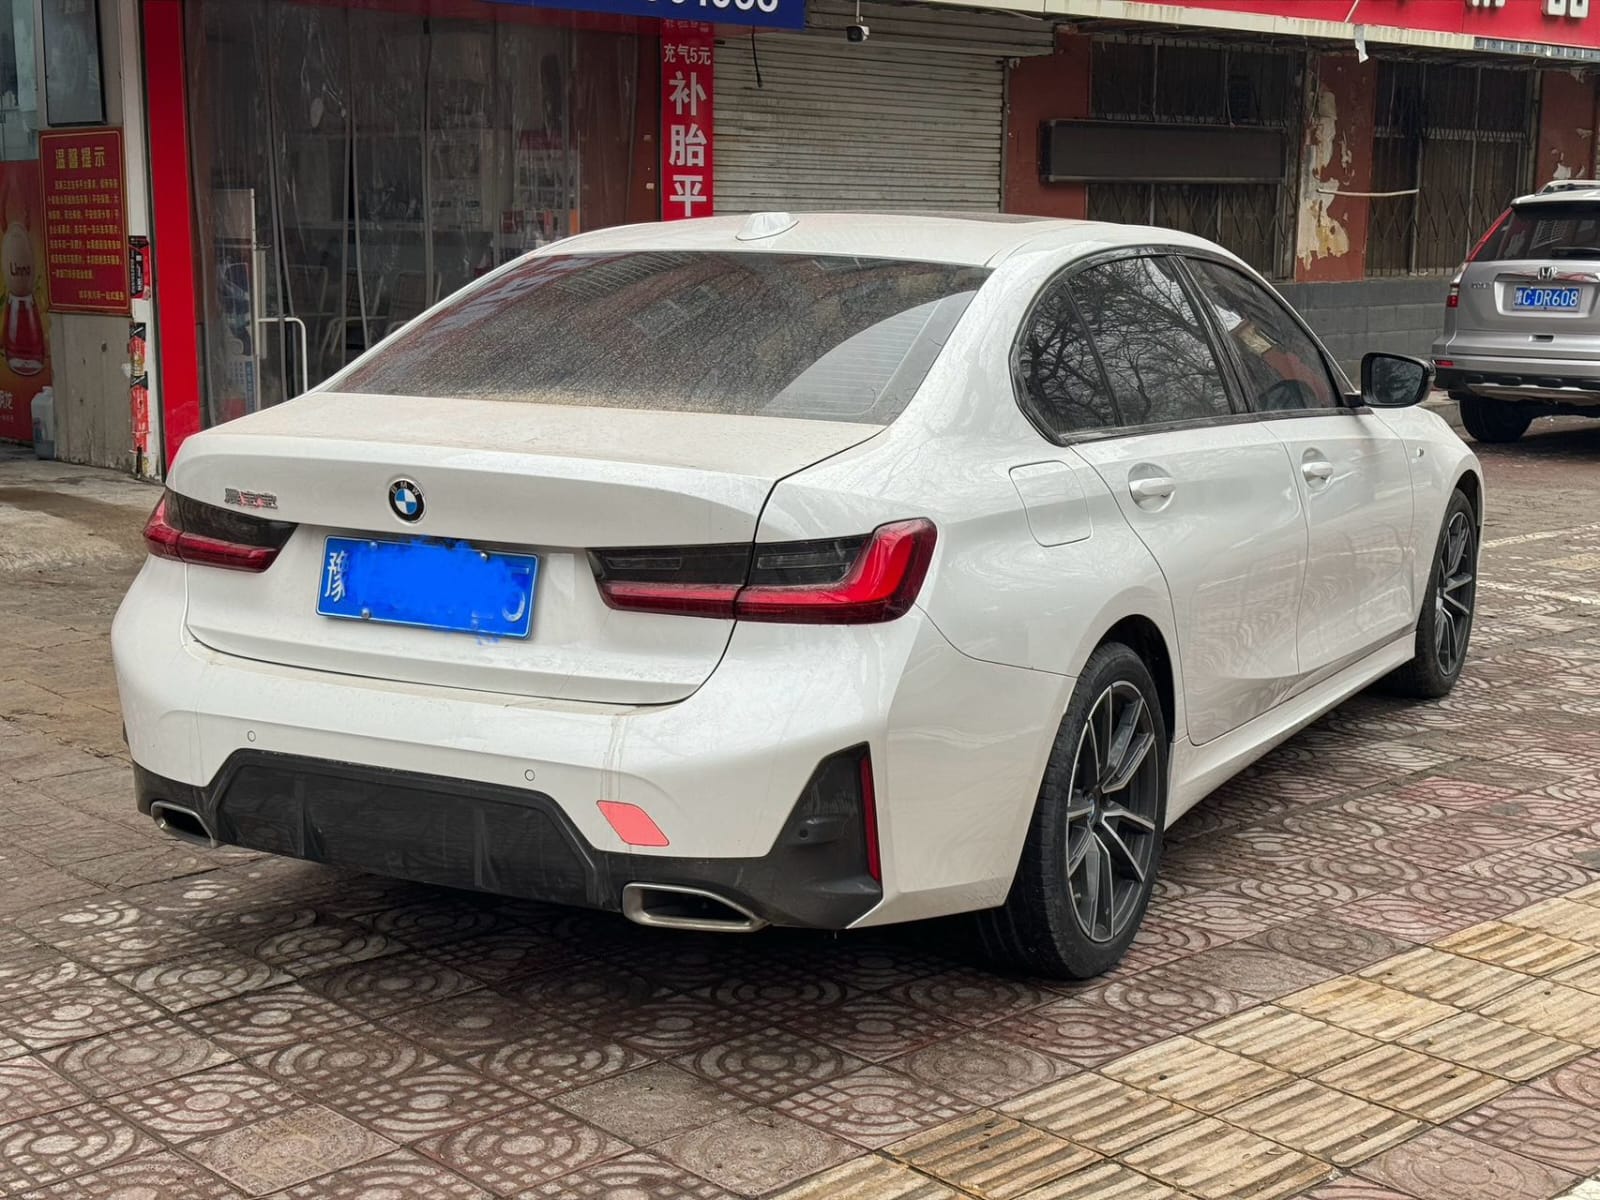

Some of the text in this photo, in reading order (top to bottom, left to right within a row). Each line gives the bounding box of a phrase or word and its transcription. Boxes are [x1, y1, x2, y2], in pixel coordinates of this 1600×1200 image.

[663, 43, 711, 65] 充气5元
[669, 71, 707, 217] 补胎平
